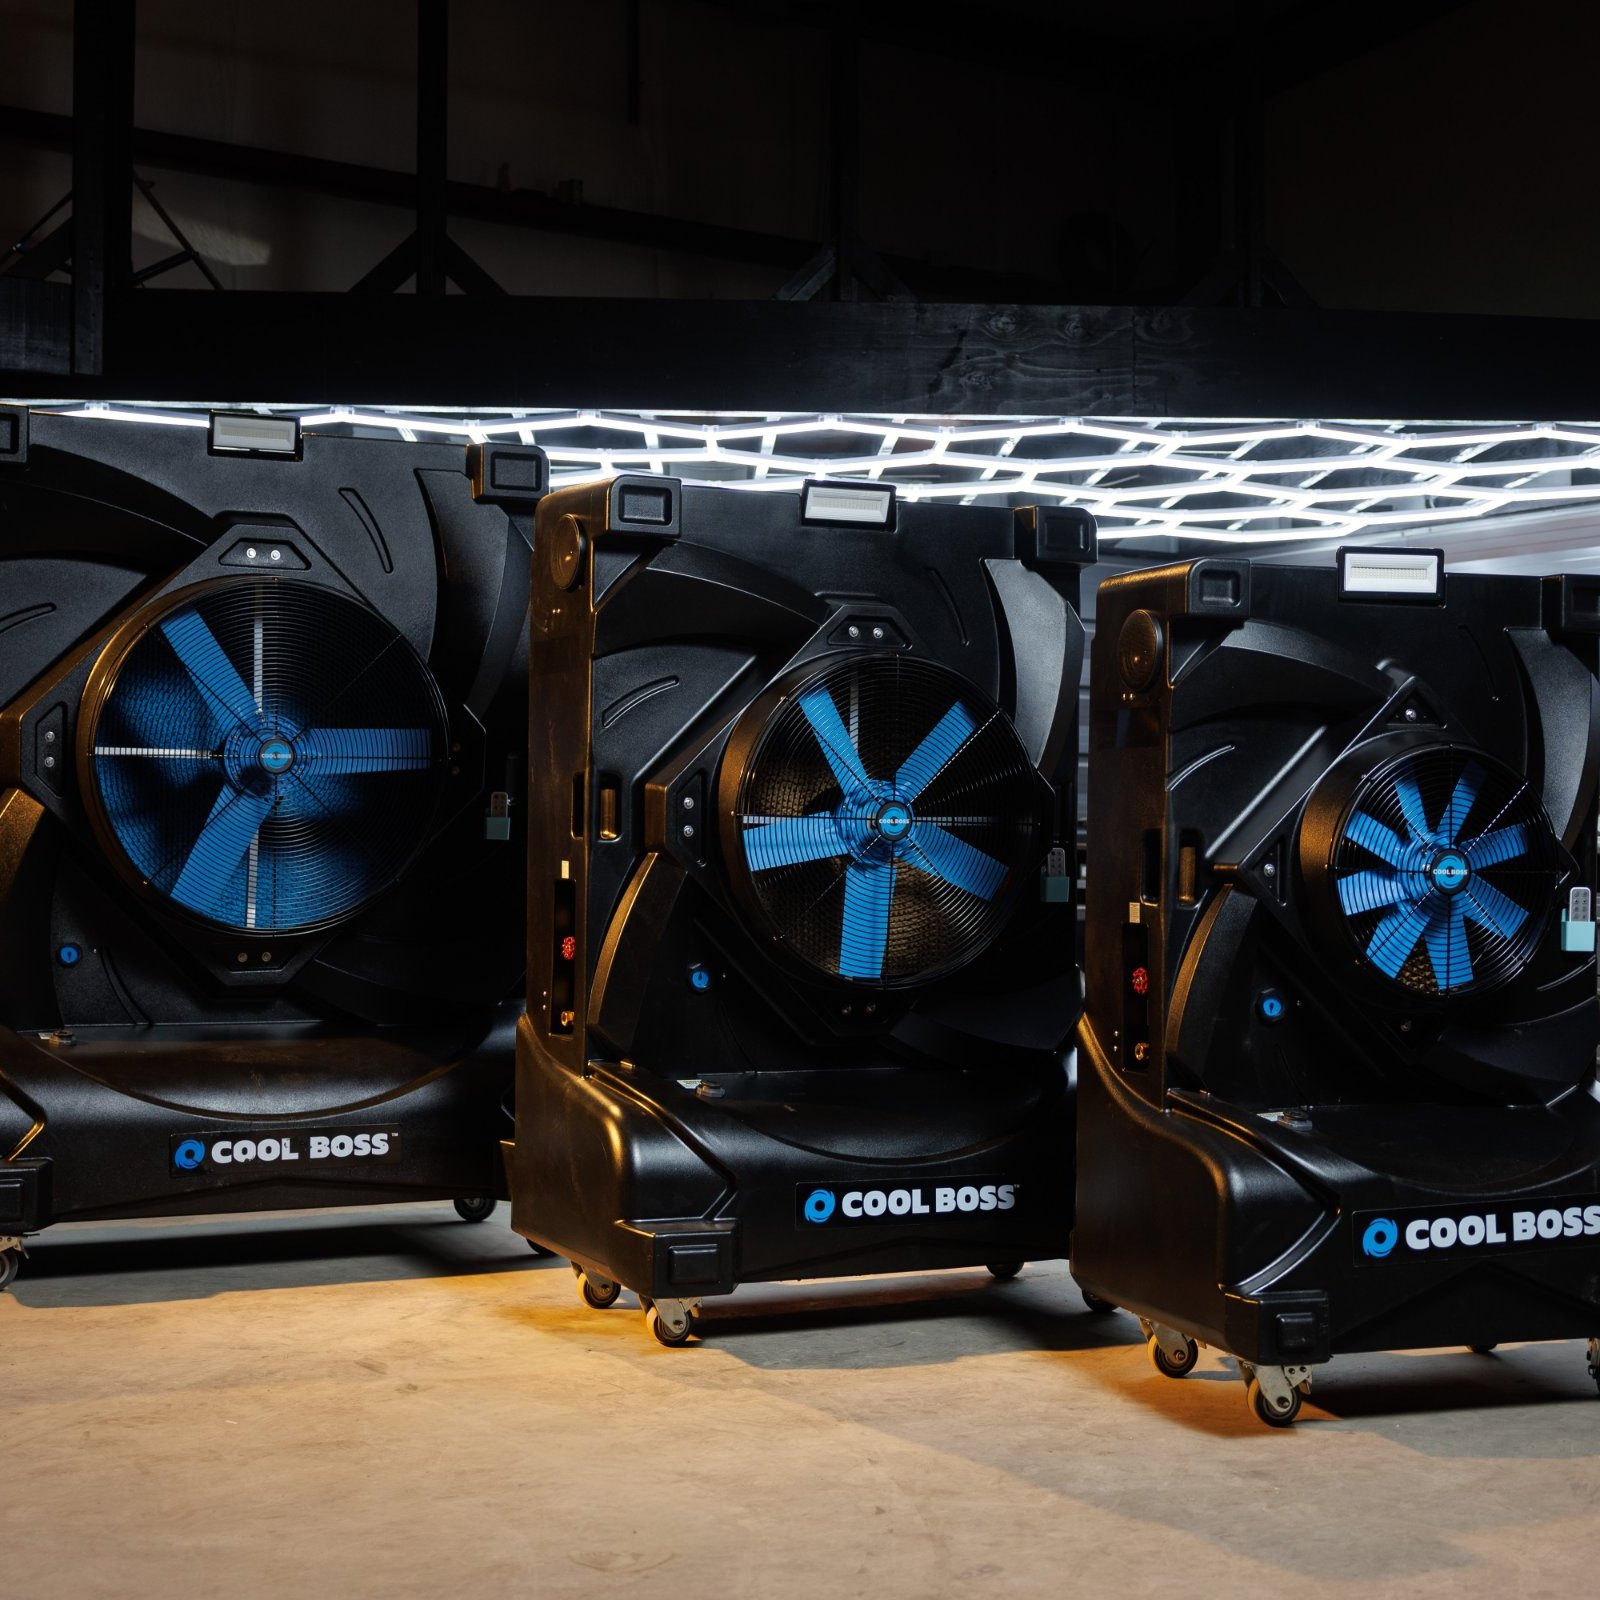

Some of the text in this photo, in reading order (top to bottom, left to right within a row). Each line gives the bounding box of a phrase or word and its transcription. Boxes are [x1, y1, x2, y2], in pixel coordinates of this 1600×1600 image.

[211, 1138, 299, 1164] COOL
[842, 1189, 930, 1218] COOL
[1405, 1205, 1600, 1250] COOL BOSS
